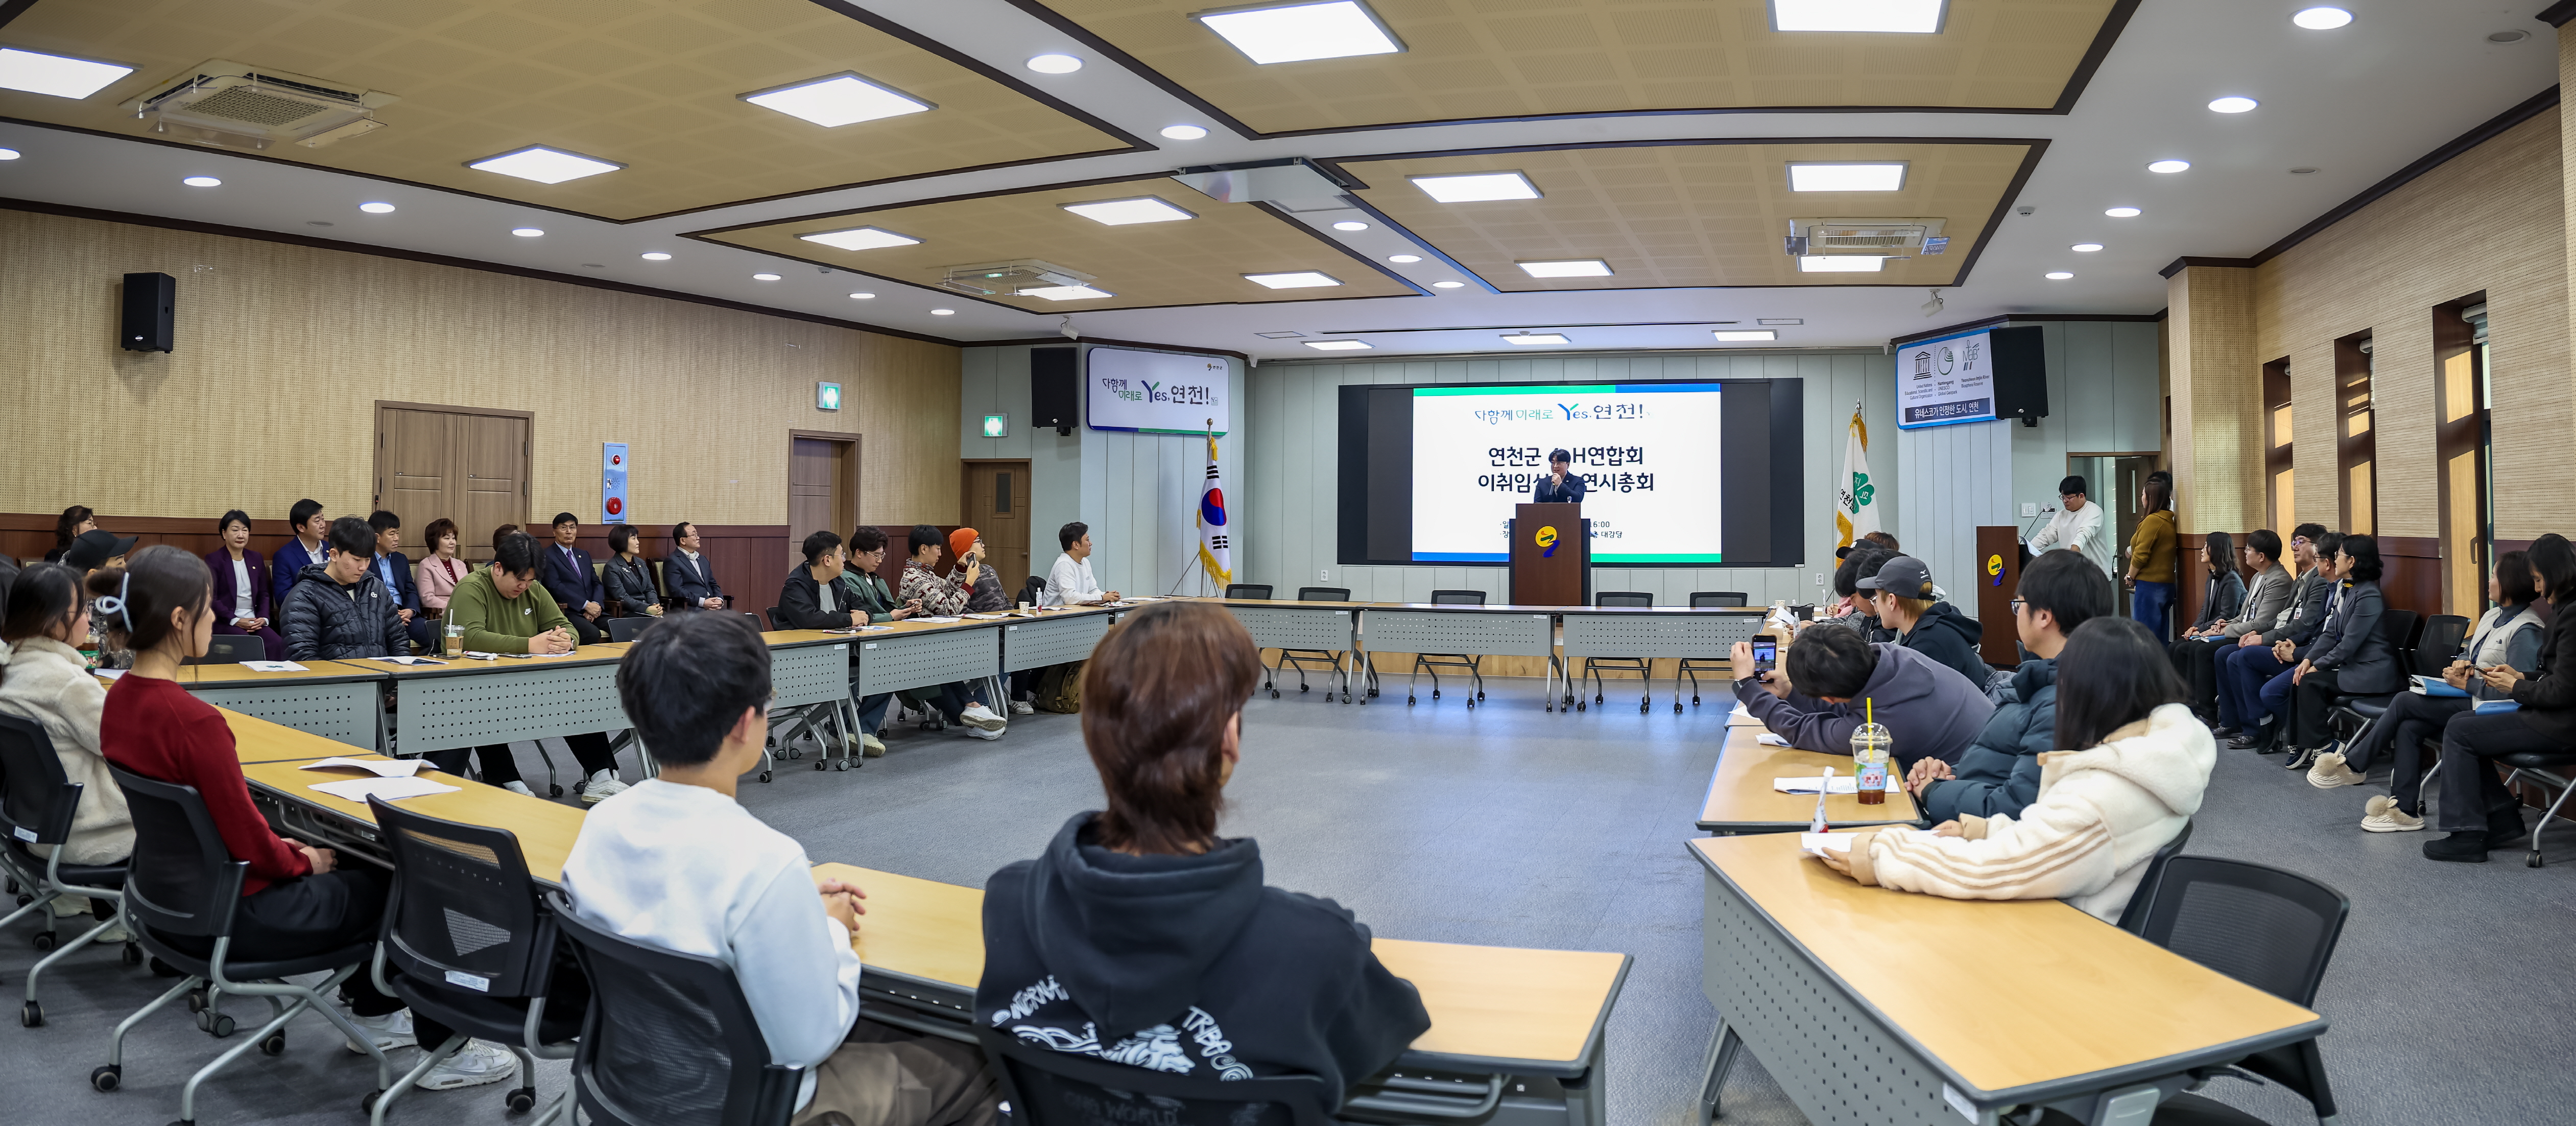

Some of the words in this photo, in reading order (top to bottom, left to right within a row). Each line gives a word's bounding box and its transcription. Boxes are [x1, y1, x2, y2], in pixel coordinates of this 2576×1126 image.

[1102, 378, 1127, 393] 다함께
[1141, 380, 1170, 403] Yes,
[1171, 385, 1209, 405] 연천!
[1118, 390, 1142, 401] 미래로
[1475, 410, 1513, 425] 다함께
[1516, 409, 1554, 420] 미래로
[1915, 407, 1939, 419] 유네스코가
[1939, 404, 1955, 416] 인정한
[1955, 403, 1968, 414] 도시,
[1969, 401, 1979, 412] 연천
[1489, 446, 1542, 466] 연천군
[1582, 472, 1654, 493] 연시총회
